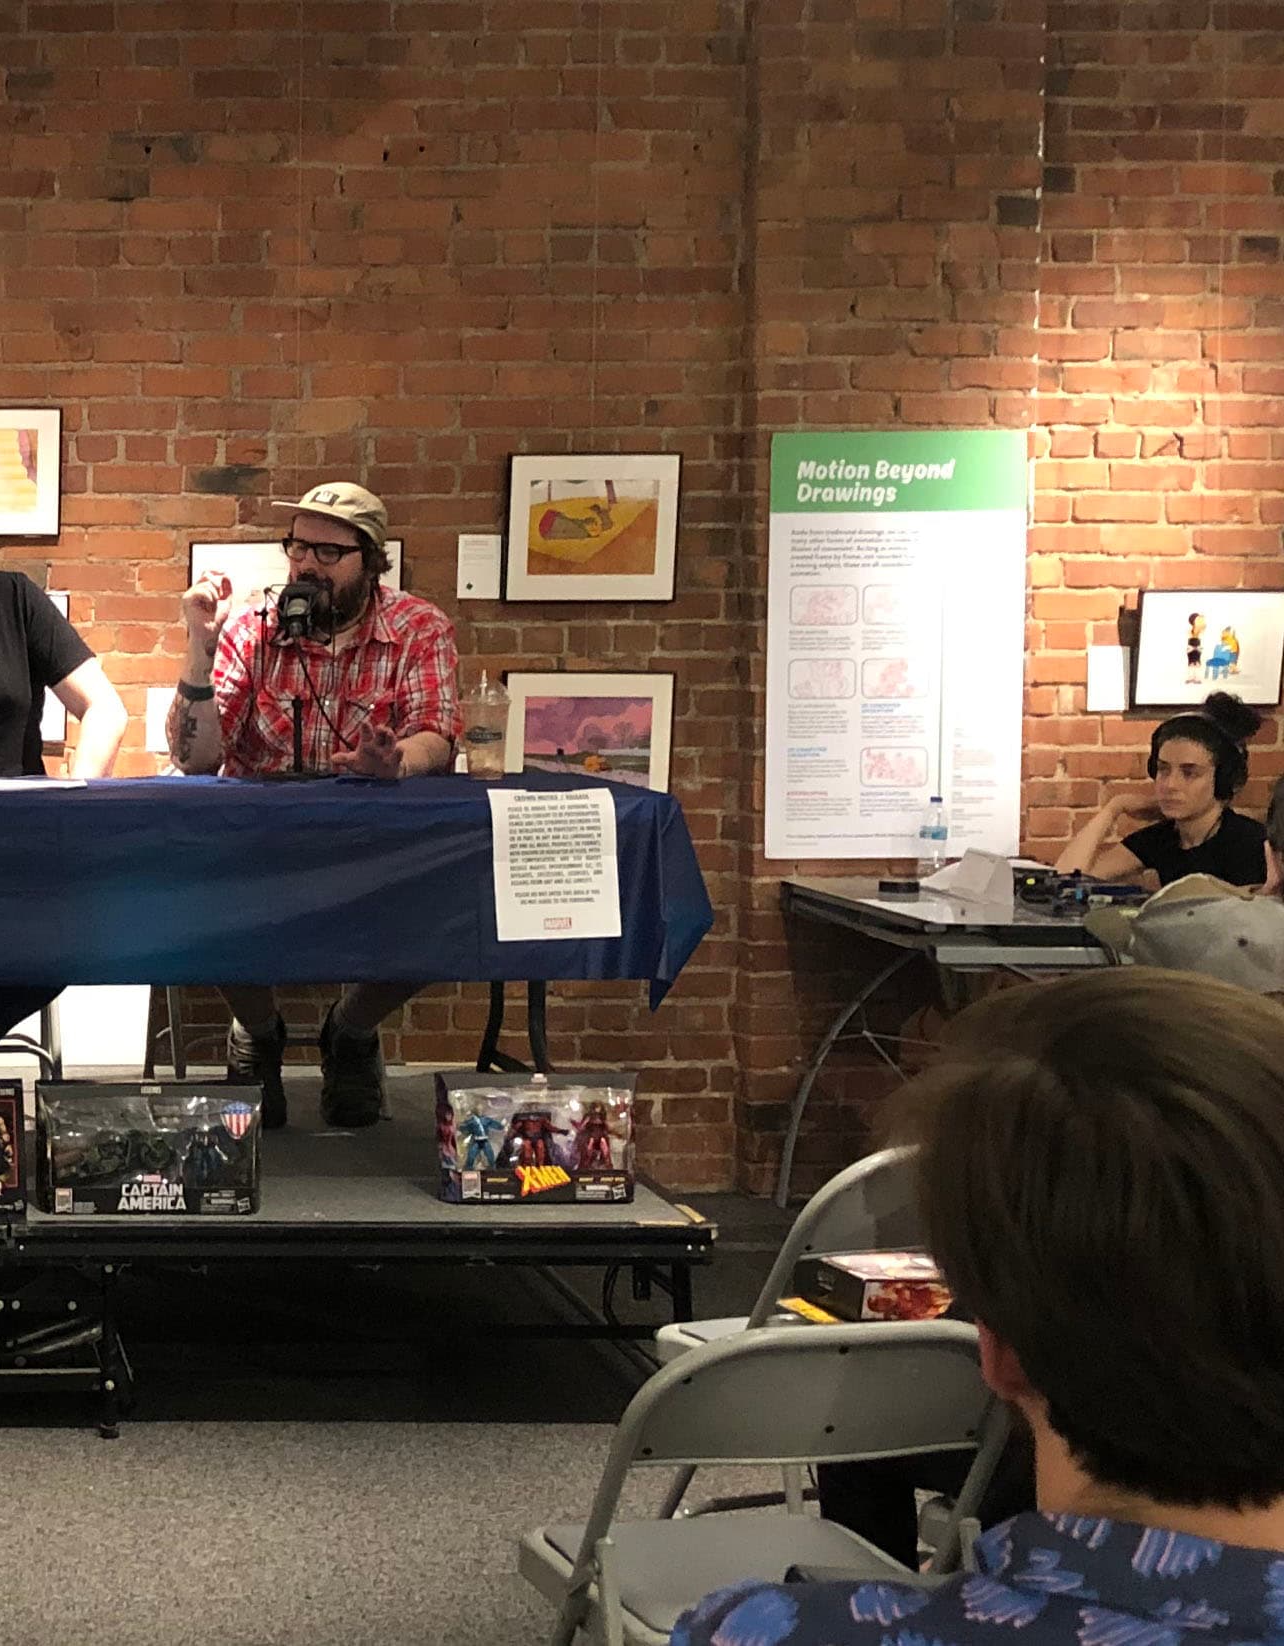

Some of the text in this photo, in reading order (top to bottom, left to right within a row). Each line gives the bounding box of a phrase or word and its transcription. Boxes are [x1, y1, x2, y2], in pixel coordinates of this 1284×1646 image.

[797, 458, 956, 484] Motion Beyond
[797, 482, 898, 507] Drawings
[121, 1183, 183, 1197] CAPTAIN
[117, 1196, 187, 1211] AMERICA
